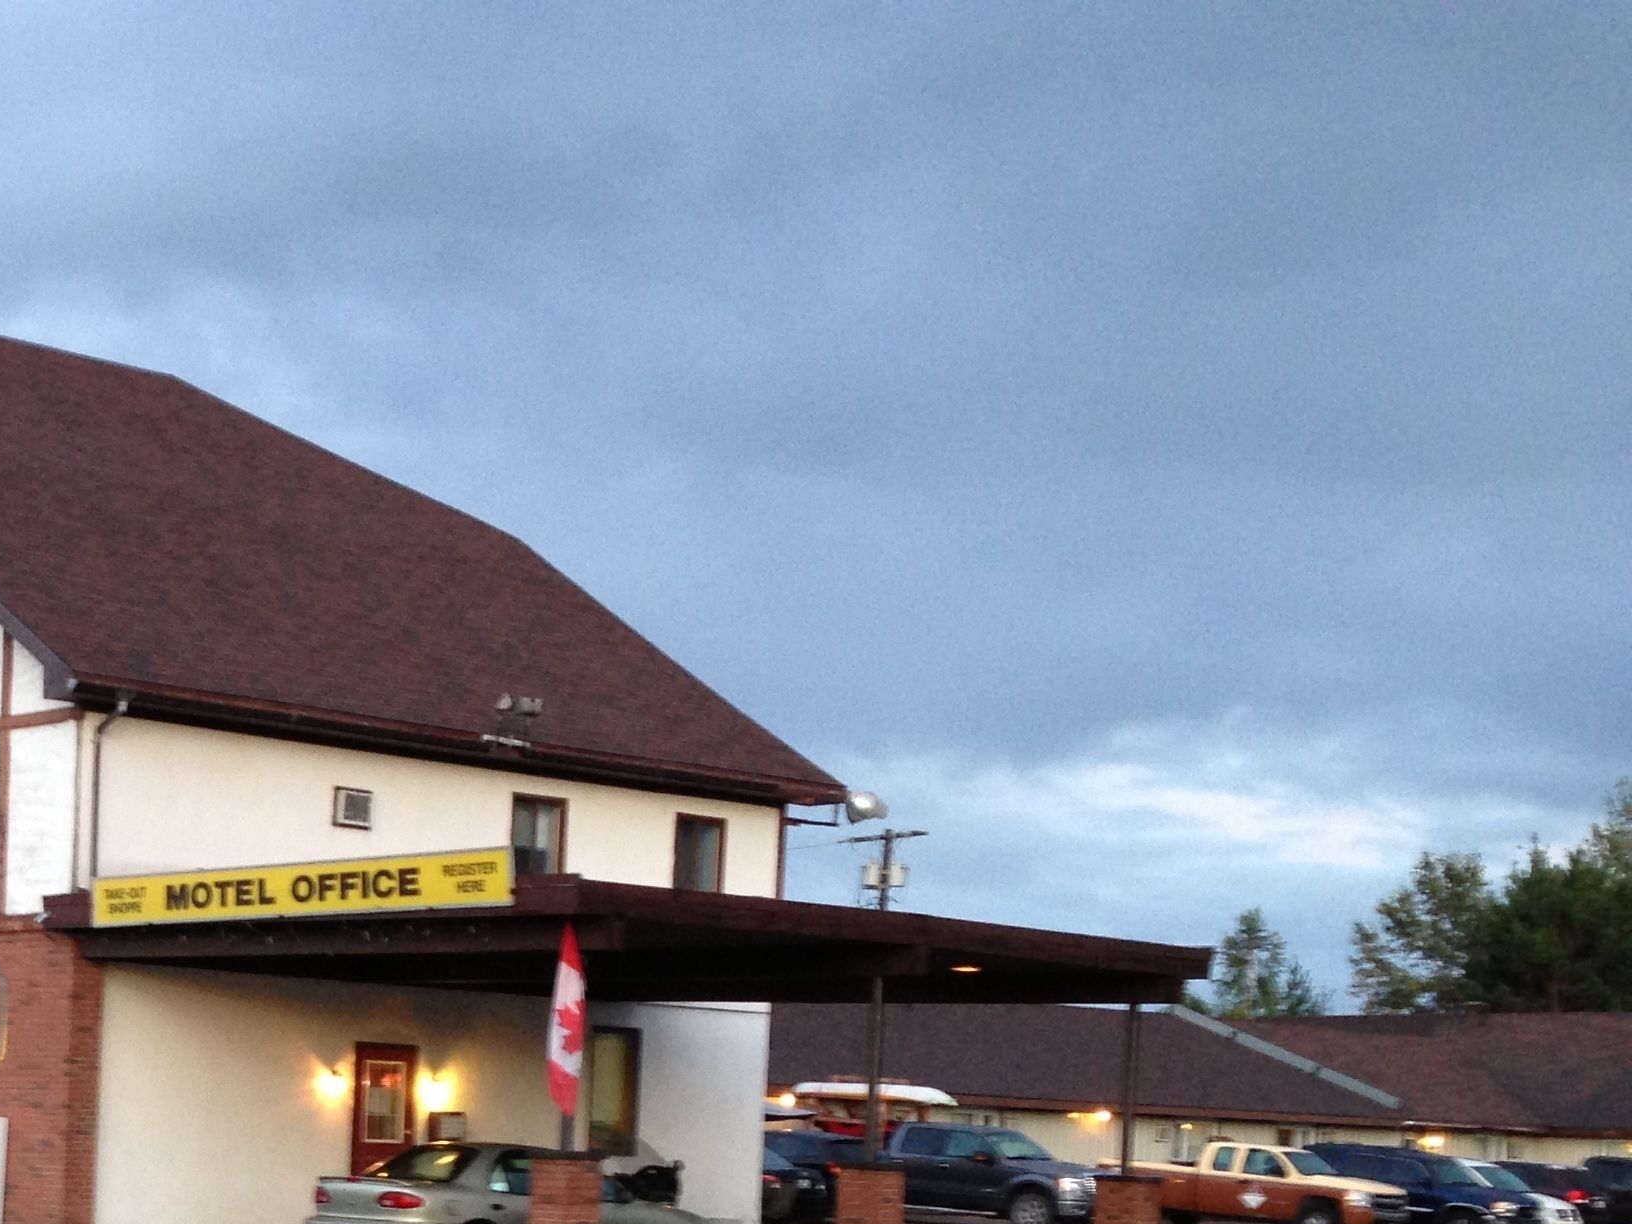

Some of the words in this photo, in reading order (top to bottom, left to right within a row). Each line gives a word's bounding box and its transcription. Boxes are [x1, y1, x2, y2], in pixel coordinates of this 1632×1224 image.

[442, 861, 498, 876] REGISTER
[104, 887, 147, 899] TAKE-OUT
[166, 878, 277, 911] MOTEL
[291, 867, 421, 903] OFFICE
[456, 880, 486, 893] HERE
